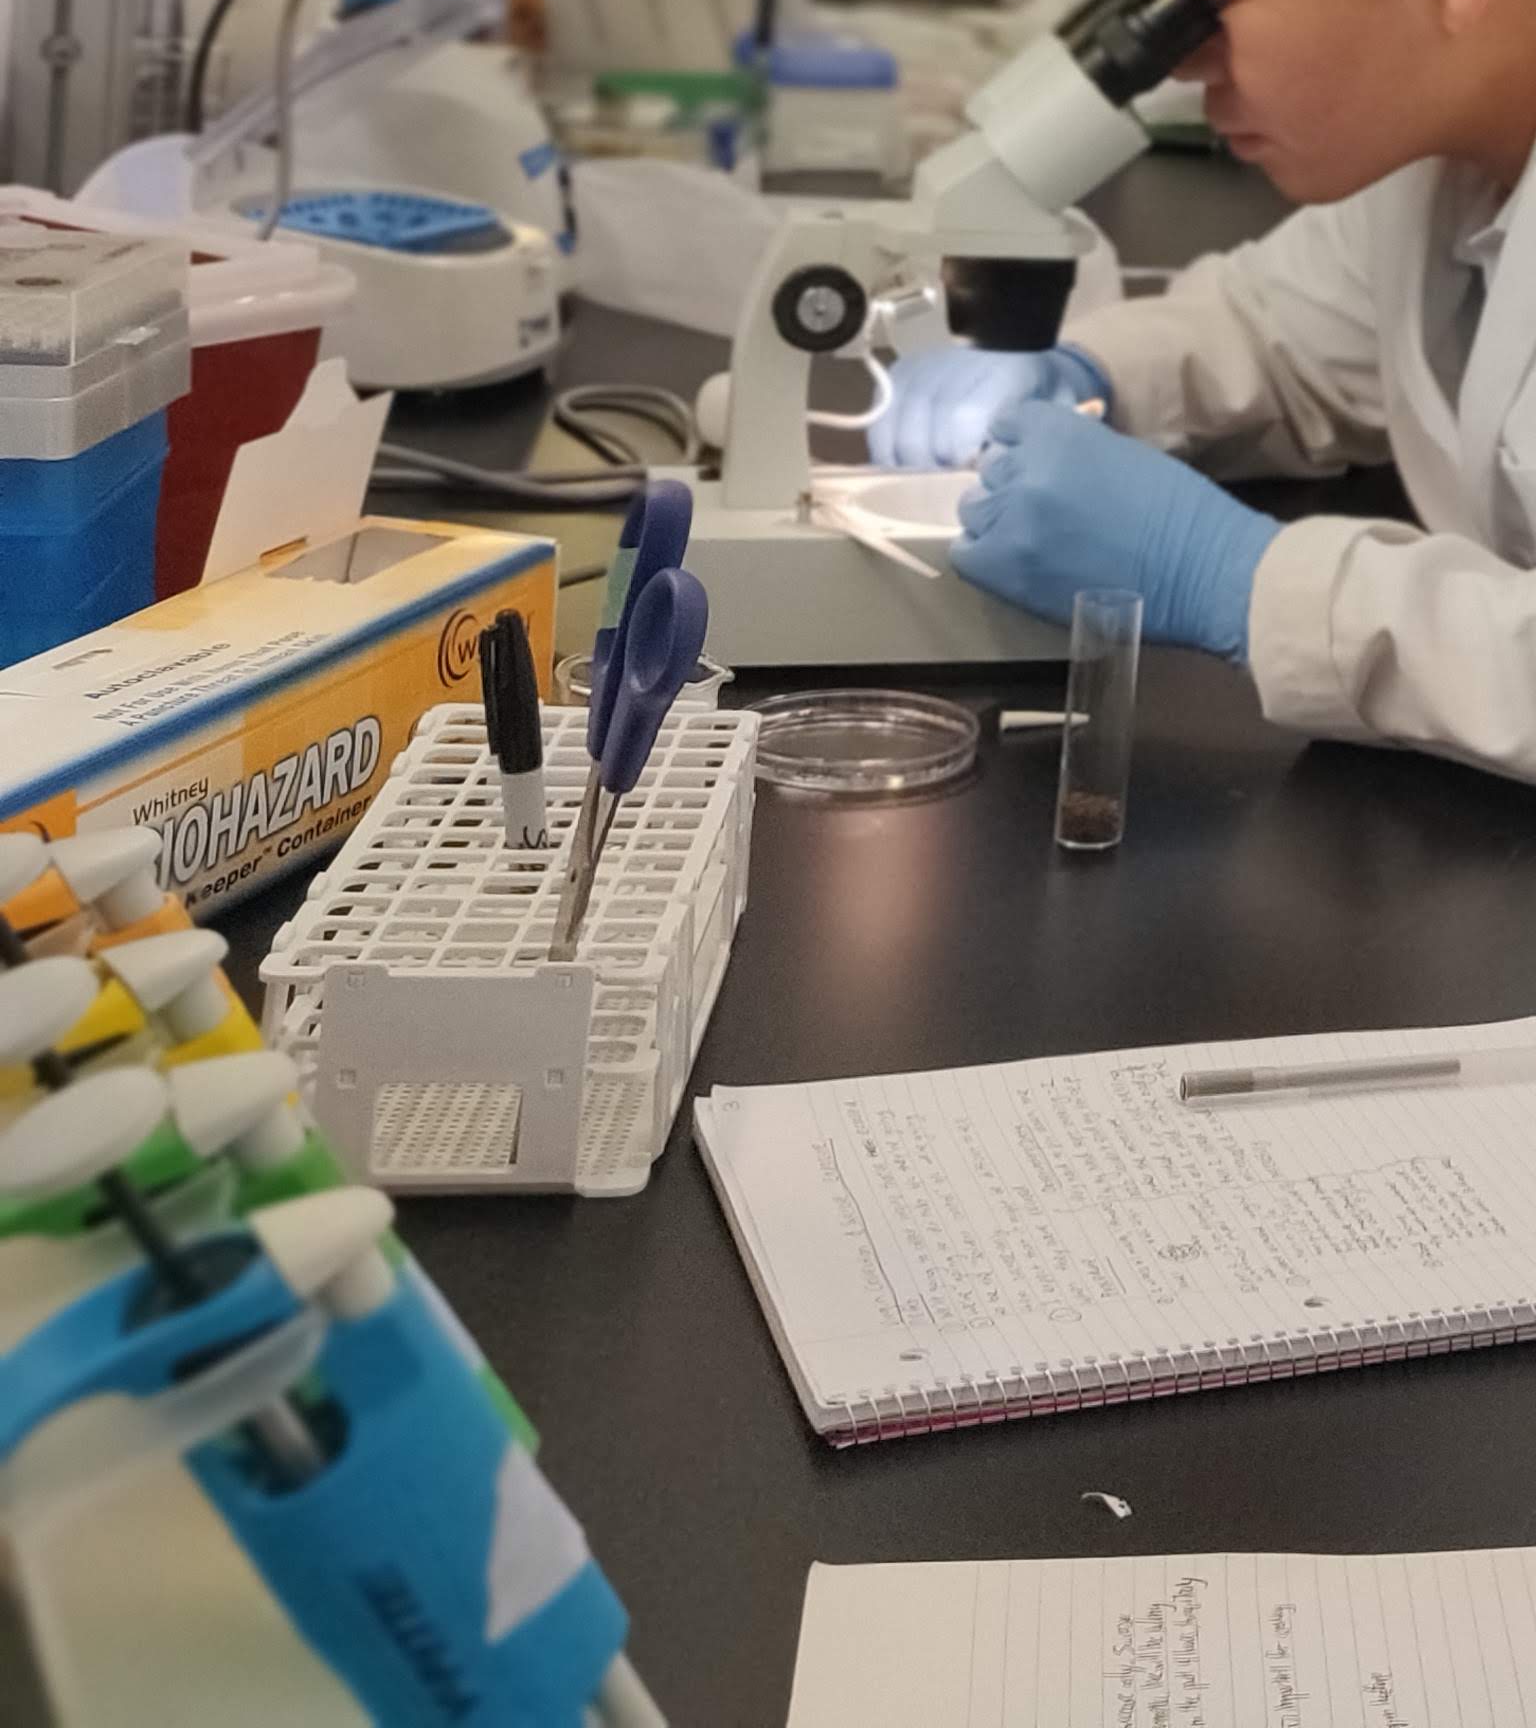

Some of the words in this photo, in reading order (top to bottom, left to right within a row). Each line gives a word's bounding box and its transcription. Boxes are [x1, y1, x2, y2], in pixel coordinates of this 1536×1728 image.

[84, 643, 231, 699] Autoclavable
[132, 777, 209, 825] Whitney
[155, 714, 382, 891] IOHAZARD
[276, 794, 372, 858] Container
